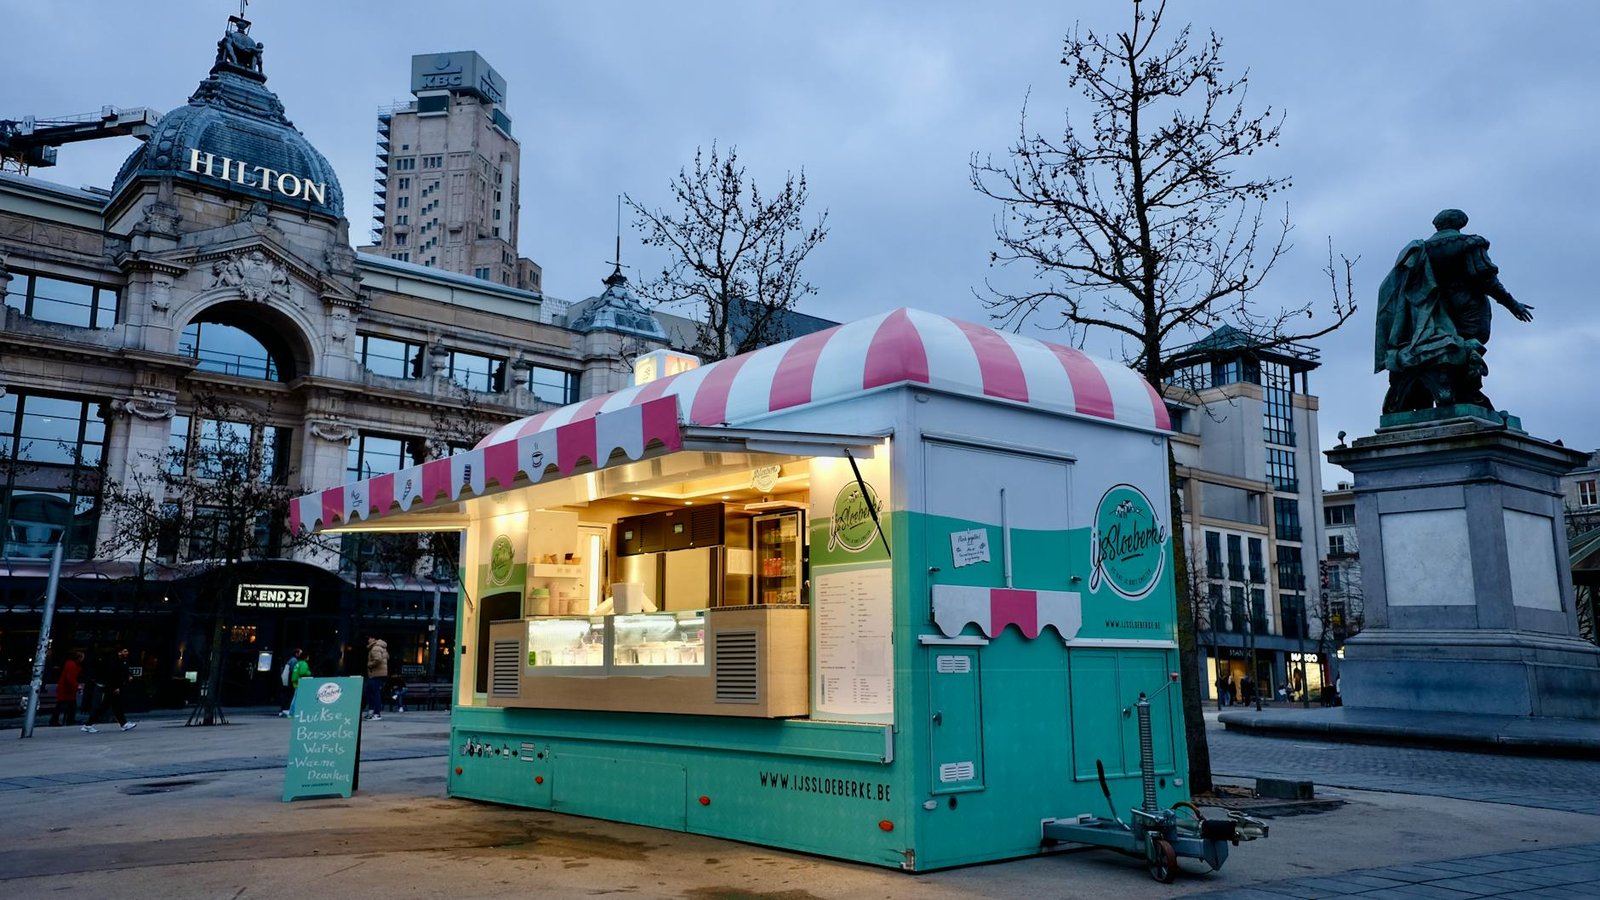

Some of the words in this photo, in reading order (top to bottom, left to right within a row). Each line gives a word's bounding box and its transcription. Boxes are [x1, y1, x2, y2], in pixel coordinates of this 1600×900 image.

[422, 74, 462, 89] KBC
[187, 147, 327, 204] HILTON
[287, 591, 303, 603] 32
[759, 771, 891, 802] WWW.IJSSLOEBERKE.BE
